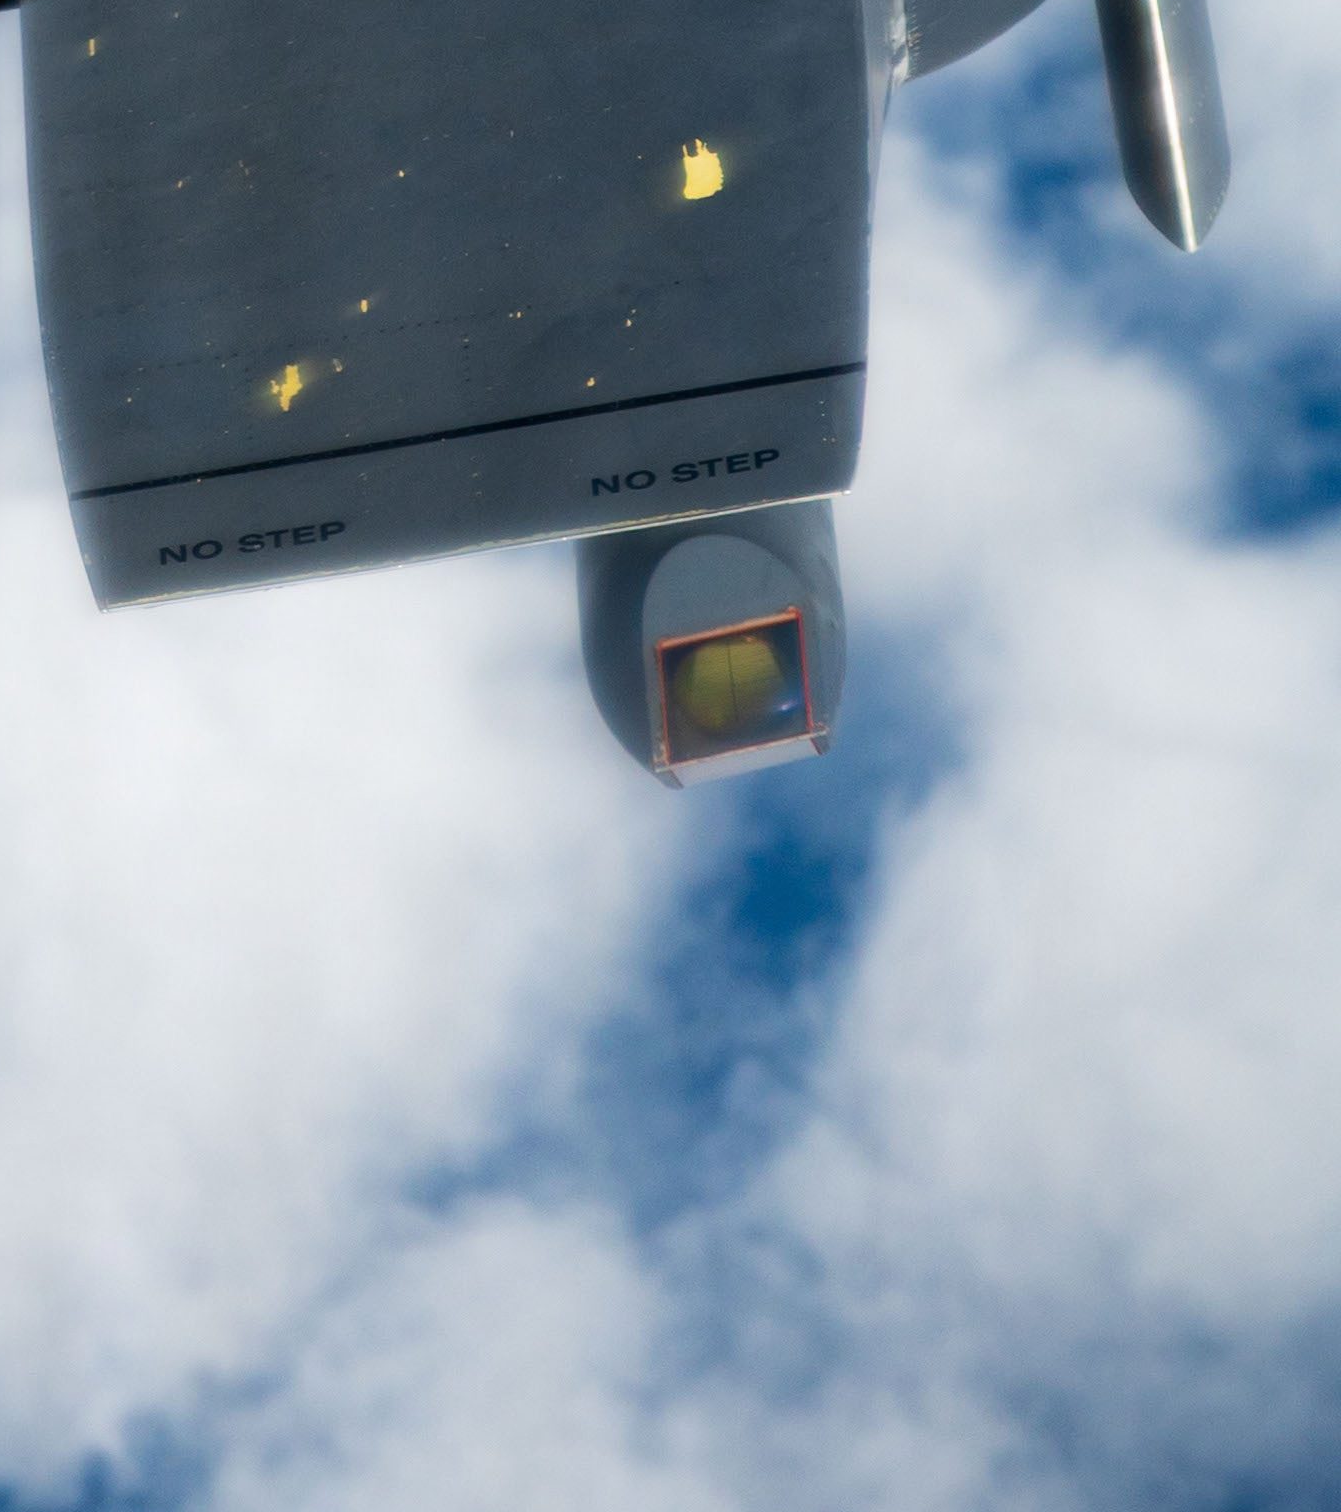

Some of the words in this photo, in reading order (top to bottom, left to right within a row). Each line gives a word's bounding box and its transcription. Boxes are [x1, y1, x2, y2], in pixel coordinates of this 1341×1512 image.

[590, 469, 657, 497] NO
[670, 447, 782, 486] STEP
[158, 538, 224, 567] NO
[237, 520, 347, 555] STEP
